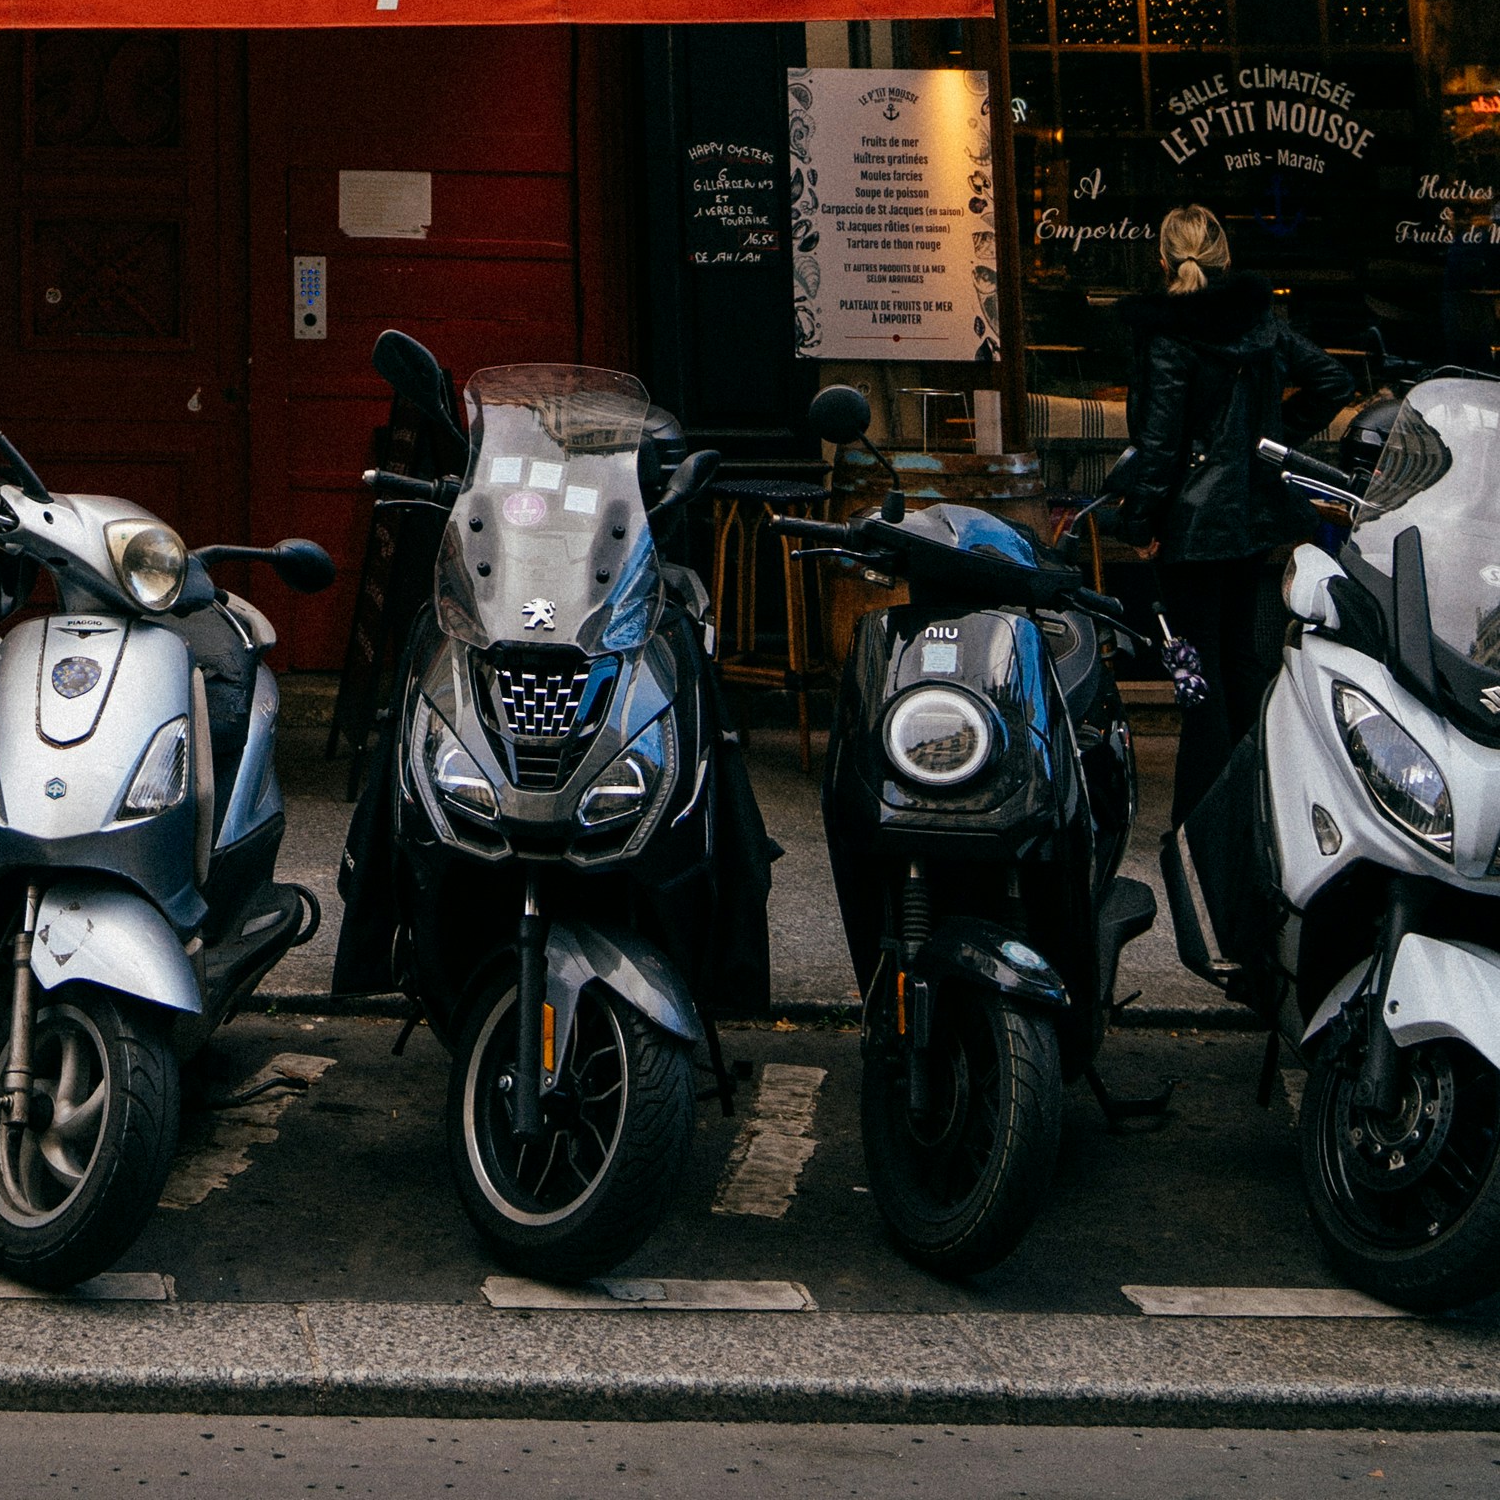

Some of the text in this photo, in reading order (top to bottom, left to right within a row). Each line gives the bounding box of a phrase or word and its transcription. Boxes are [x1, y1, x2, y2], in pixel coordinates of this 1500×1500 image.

[858, 94, 869, 106] LE
[888, 87, 919, 104] MOUSSE
[1168, 73, 1229, 116] SALLE
[1159, 126, 1197, 165] LE
[1266, 100, 1375, 159] MOUSSE
[861, 136, 919, 148] Fruits de mer
[688, 141, 774, 164] HAPPY OYSTERS
[853, 152, 928, 166] Huîtres gratinées
[1224, 148, 1261, 171] Paris
[1277, 148, 1325, 174] Marais
[860, 170, 923, 182] Moules farcies
[1074, 167, 1106, 200] A
[715, 194, 729, 203] ET
[855, 187, 929, 200] Soupe de poisson
[705, 205, 736, 216] VERRE
[738, 205, 754, 215] DE
[821, 203, 965, 217] Carpaccio de St Jacques (en saison)
[1440, 206, 1454, 221] &
[720, 216, 770, 227] TOURAINE
[836, 220, 951, 234] St Jacques rôties (en saison)
[1036, 208, 1156, 252] Emporter
[1395, 220, 1455, 244] Fruits
[1462, 224, 1483, 244] de
[847, 237, 941, 252] Tartare de thon rouge
[694, 252, 709, 263] DE
[844, 263, 946, 274] ET AUTRES PRODUITS DE LA MER
[866, 274, 924, 284] SELON ARRIVAGES
[840, 300, 953, 312] PLATEAUX DE FRUITS DE MER
[871, 312, 922, 325] À EMPORTER
